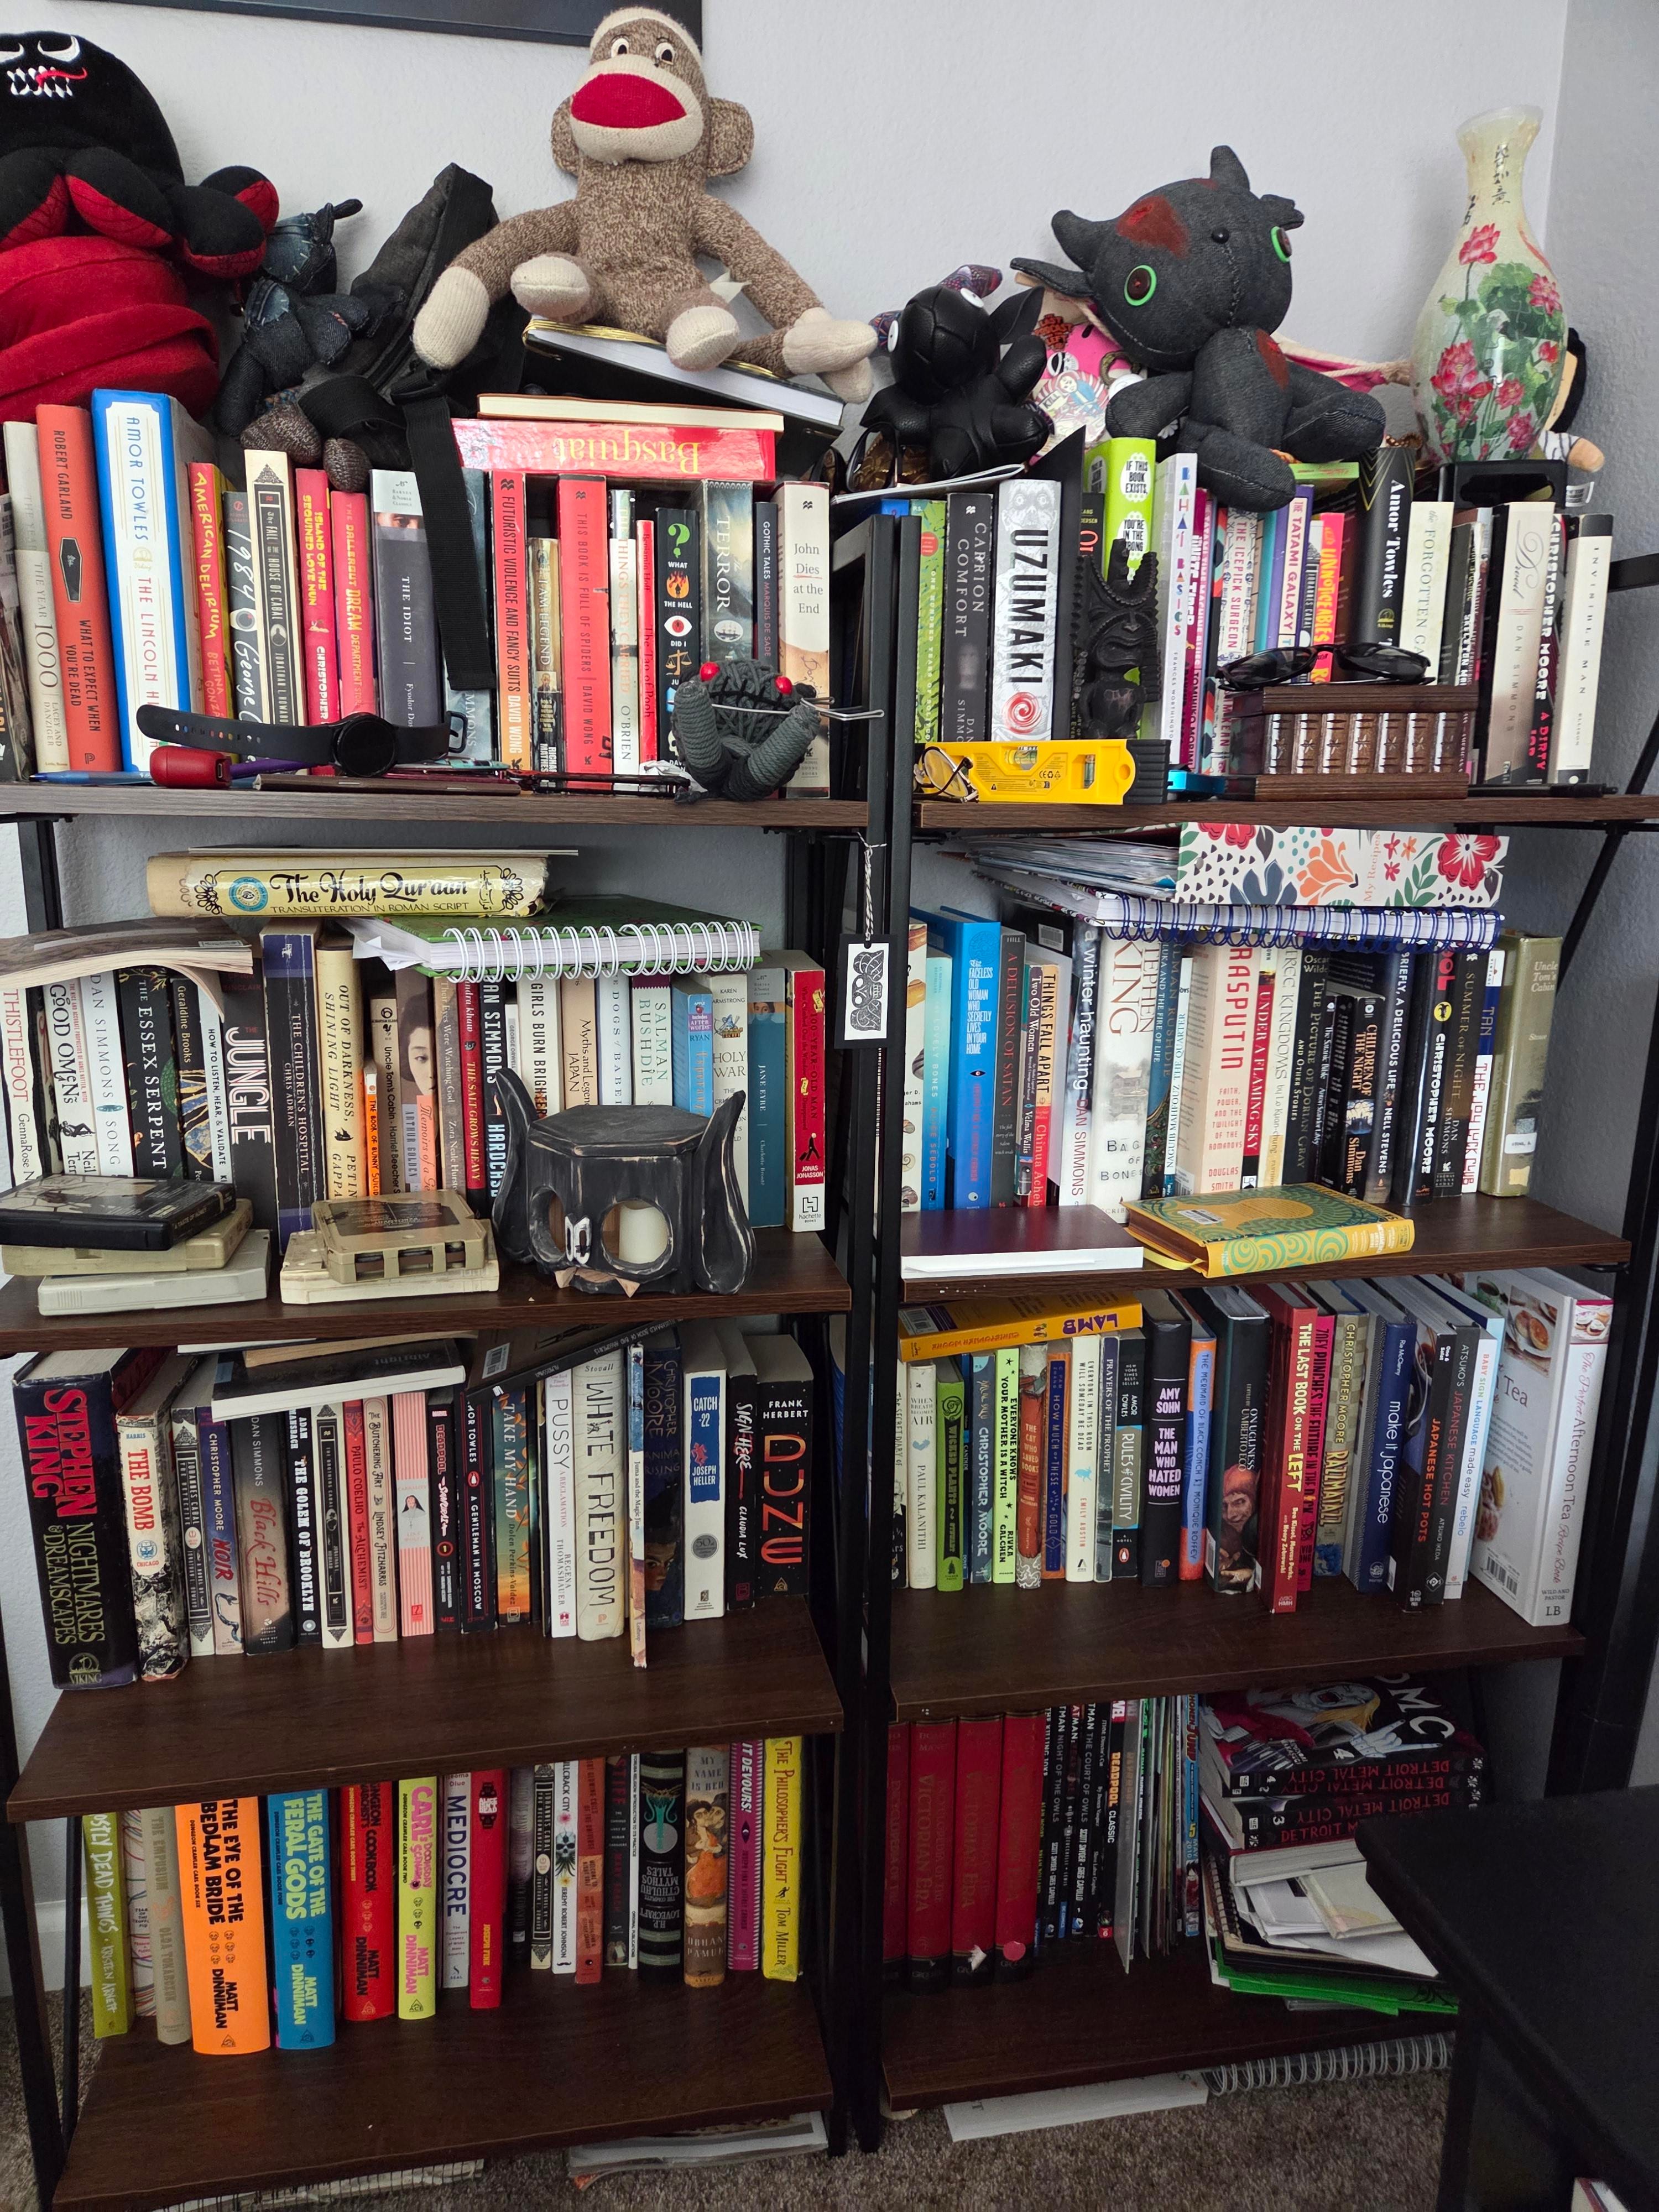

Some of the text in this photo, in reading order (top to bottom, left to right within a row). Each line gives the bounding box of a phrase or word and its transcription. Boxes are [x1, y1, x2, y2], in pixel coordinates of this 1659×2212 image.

[54, 430, 74, 520] ROBERT GARLAND
[126, 417, 148, 540] AMOR TOWLES
[554, 429, 700, 474] Basquiat
[194, 472, 219, 639] AMERICAN DELIRIUM
[302, 495, 317, 606] SEQUINED LOVE NUN
[315, 512, 327, 591] ISLAND THE
[716, 515, 731, 612] TERROR
[794, 543, 820, 556] John
[796, 563, 820, 575] Dies
[974, 523, 987, 613] CARRION
[1283, 515, 1302, 630] TATAMI GALAXY
[1383, 479, 1406, 598] Amor Towles
[401, 576, 412, 643] THE IDIOT
[502, 496, 520, 692] FUTURISTIC VIOLENCE FANCY SUITS
[798, 603, 820, 614] End
[806, 584, 823, 595] the
[955, 538, 968, 637] COMFORT
[1006, 529, 1049, 684] UZUMAKI
[1536, 521, 1562, 700] CHRISTOPHER MOORE
[65, 644, 81, 707] YOU'RE DEAD
[79, 619, 101, 732] WHAT EXPECT WHEN
[141, 613, 158, 682] LINCOLN
[508, 695, 523, 754] DAVID WONG
[269, 873, 320, 904] The
[320, 869, 377, 905] Holy
[270, 902, 469, 914] TRANSLITERATION IN ROMAN SCRIPT
[1109, 938, 1140, 1036] KING
[1531, 982, 1555, 992] Cabin
[1533, 972, 1556, 982] Tom's
[1534, 961, 1558, 971] Uncle
[3, 988, 29, 1102] THISTLEFOOT
[90, 974, 113, 1098] DAN SIMMONS
[484, 1011, 502, 1084] SIMMONS
[639, 999, 653, 1087] RUSHDIE
[655, 1002, 669, 1081] SALMAN
[1076, 953, 1098, 1091] winter haunting
[1220, 948, 1253, 1070] RASPUTIN
[138, 1006, 167, 1169] ESSEX SERPENT
[225, 1026, 272, 1145] JUNGLE
[324, 992, 340, 1112] SHINING LIGHT
[338, 984, 355, 1122] OUT DARKNESS,
[530, 983, 547, 1118] GIRLS BURN BRIGHTER
[565, 1052, 580, 1093] JAPAN
[712, 1051, 746, 1063] HOLY
[714, 1066, 746, 1077] WAR
[1245, 991, 1272, 1150] UNDER FLAMING SKY
[105, 1121, 121, 1165] SONG
[294, 1042, 313, 1174] CHILDREN'S HOSPITAL
[1421, 1033, 1446, 1174] CHRISTOPHER MOORE
[796, 1171, 823, 1180] JONASSON
[1062, 1313, 1118, 1334] LAMB
[586, 1383, 614, 1457] WHITE
[693, 1397, 717, 1411] CATCH
[763, 1410, 808, 1419] HERBERT
[769, 1400, 802, 1408] FRANK
[1156, 1401, 1181, 1414] SOHN
[1159, 1387, 1181, 1400] AMY
[1335, 1323, 1357, 1444] CHRISTOPHER MOORE
[1504, 1375, 1528, 1407] Tea
[25, 1415, 64, 1498] KING
[44, 1388, 97, 1518] STEPHEN
[503, 1404, 518, 1519] TAKE MY HAND
[552, 1399, 571, 1469] PUSSY
[692, 1465, 716, 1477] JOSEPH
[1154, 1441, 1178, 1454] MAN
[1376, 1401, 1401, 1524] make Japanese
[1560, 1414, 1585, 1521] Afternoon Tea
[127, 1449, 154, 1531] THE BOMB
[693, 1475, 716, 1486] HELLER
[977, 1427, 989, 1557] CHRISTOPHER MOORE
[1148, 1484, 1180, 1496] WOMEN
[1149, 1469, 1181, 1483] HATED
[211, 1537, 235, 1581] NOIR
[294, 1459, 314, 1611] THE GOLEM BROOKLYN
[587, 1473, 615, 1606] FREEDOM
[45, 1534, 78, 1645] DREAMSCAPES
[66, 1523, 105, 1642] NIGHTMARES
[1545, 1606, 1561, 1617] LB
[70, 1673, 102, 1685] VIKING
[1107, 1752, 1121, 1844] DEADPOOL CLASSIC
[1290, 1760, 1450, 1782] DETROIT METAL CITY
[201, 1802, 226, 1926] BEDLAM BRIDE
[221, 1799, 244, 1924] THE EYE OF THE
[283, 1798, 307, 1920] FERAL GODS
[446, 1795, 467, 1917] MEDIOCRE
[212, 1969, 228, 2028] DINNIMAN
[291, 1964, 307, 2025] DINNIMAN
[405, 1935, 417, 1994] DINNIMAN
